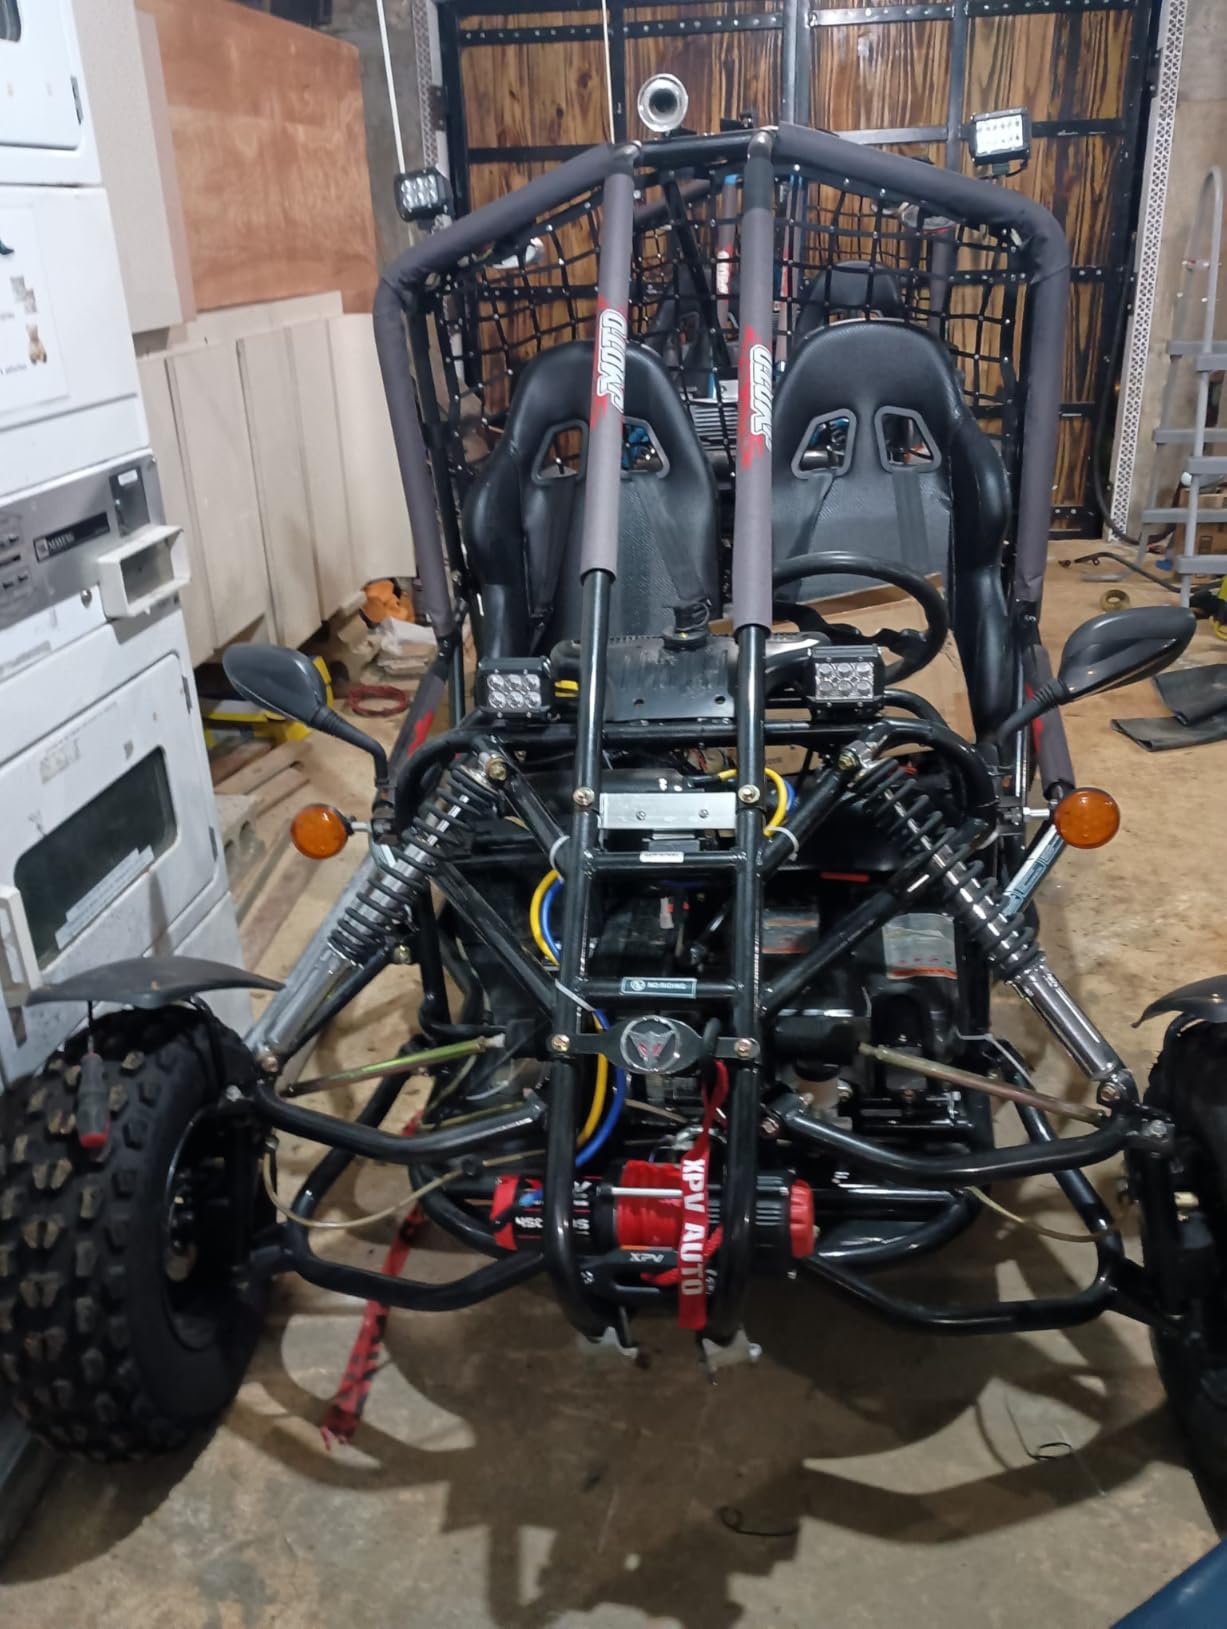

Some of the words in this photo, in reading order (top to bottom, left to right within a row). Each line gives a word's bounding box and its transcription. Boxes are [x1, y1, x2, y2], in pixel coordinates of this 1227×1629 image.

[682, 1159, 706, 1214] XPV
[630, 1252, 664, 1263] XPV
[680, 1222, 706, 1296] AUTO
